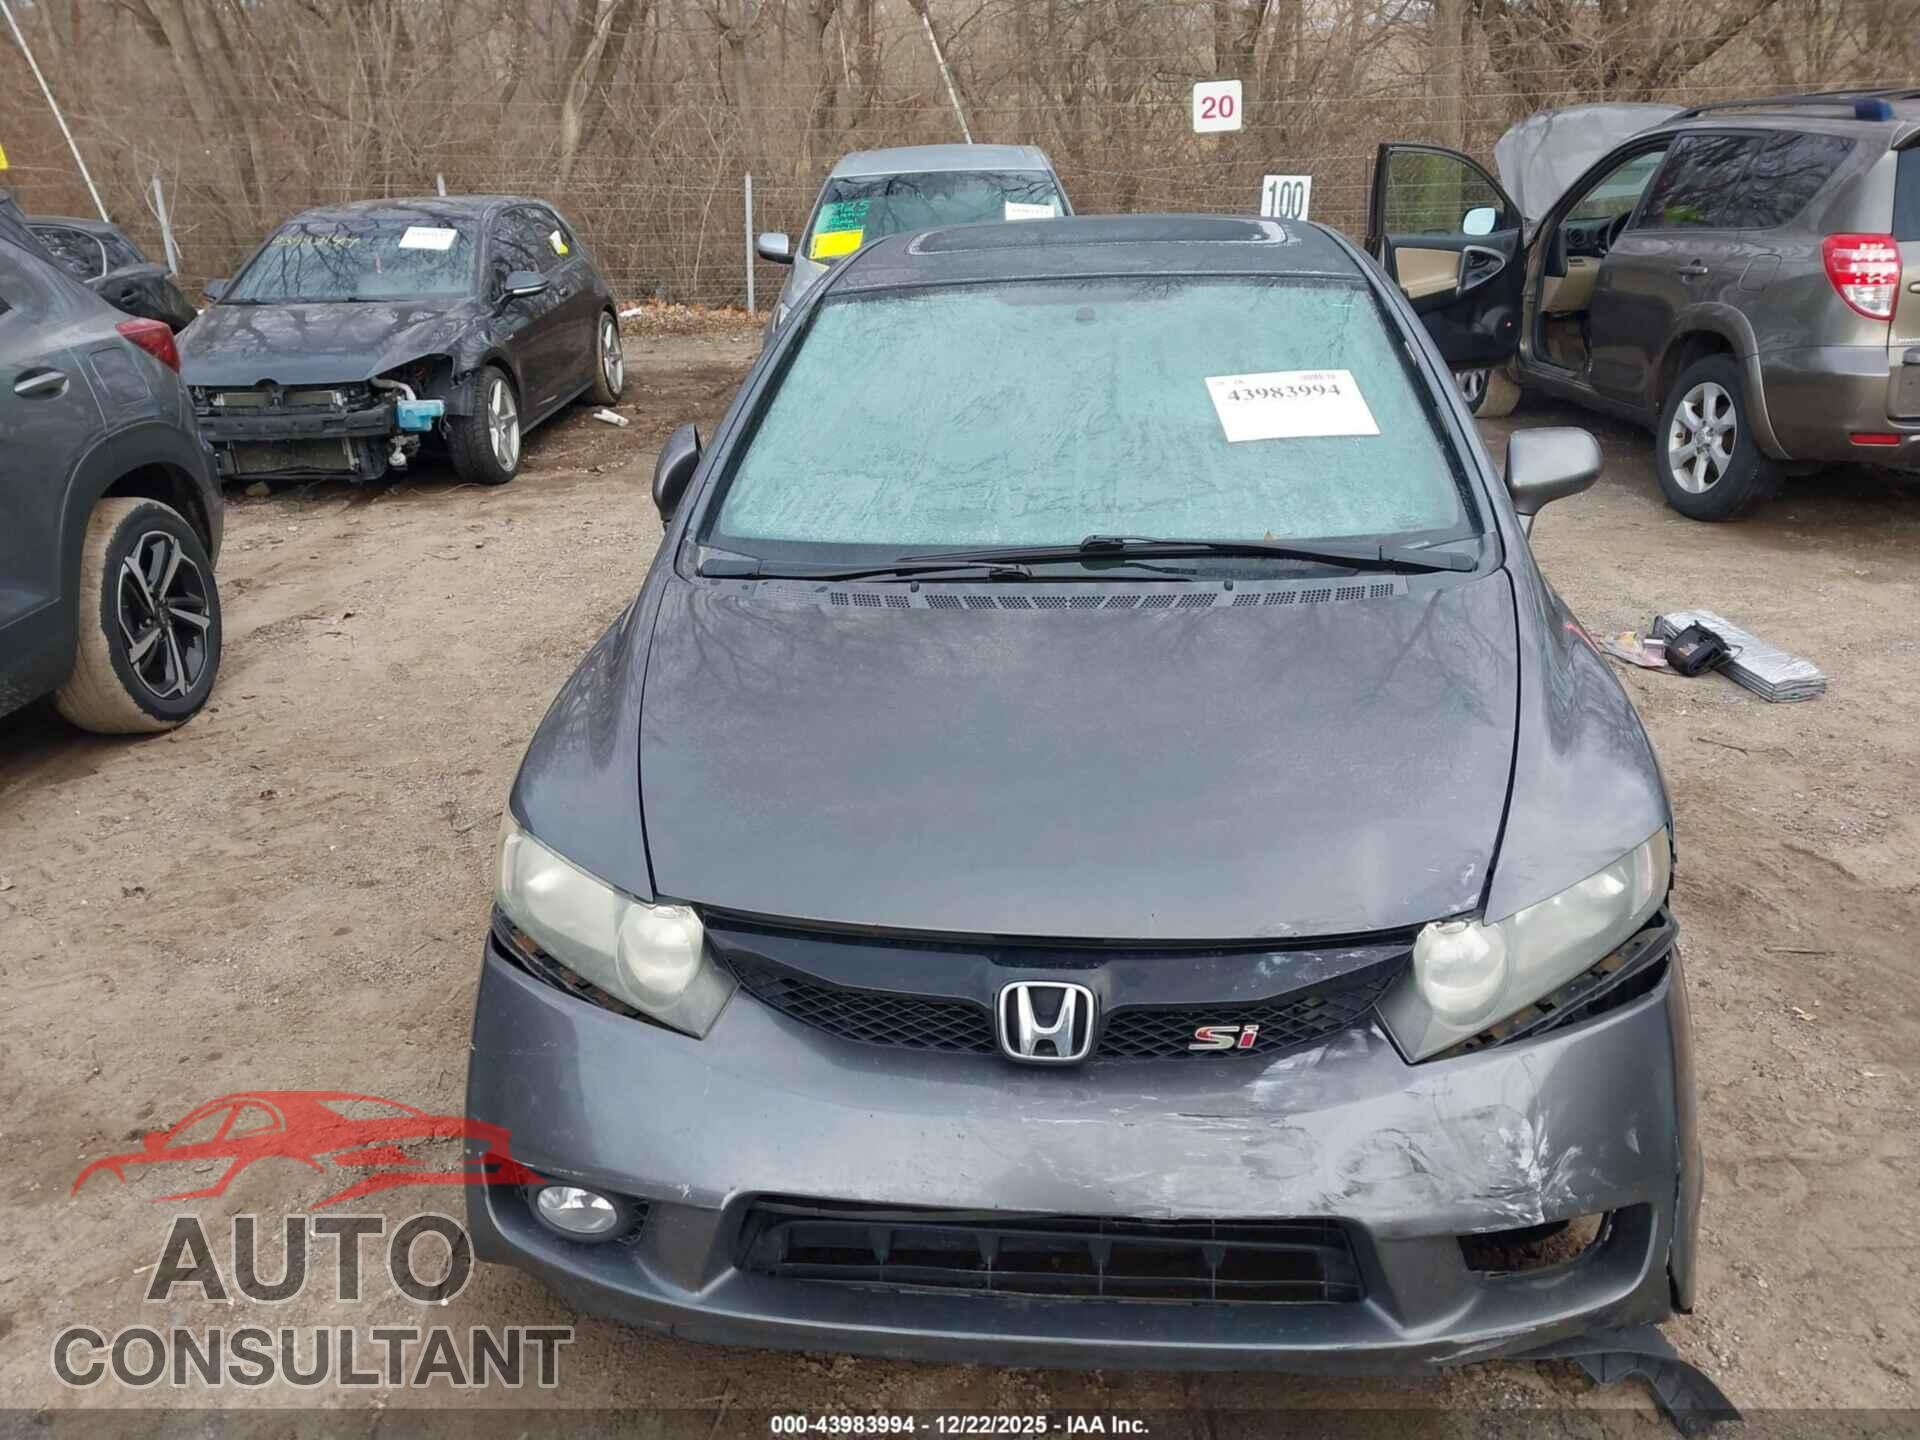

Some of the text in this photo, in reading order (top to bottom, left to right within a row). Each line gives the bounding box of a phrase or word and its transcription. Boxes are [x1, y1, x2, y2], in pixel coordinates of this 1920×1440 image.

[1201, 95, 1234, 119] 20
[1268, 180, 1304, 219] 100
[1228, 383, 1341, 401] 43983994
[1188, 1024, 1259, 1050] Si
